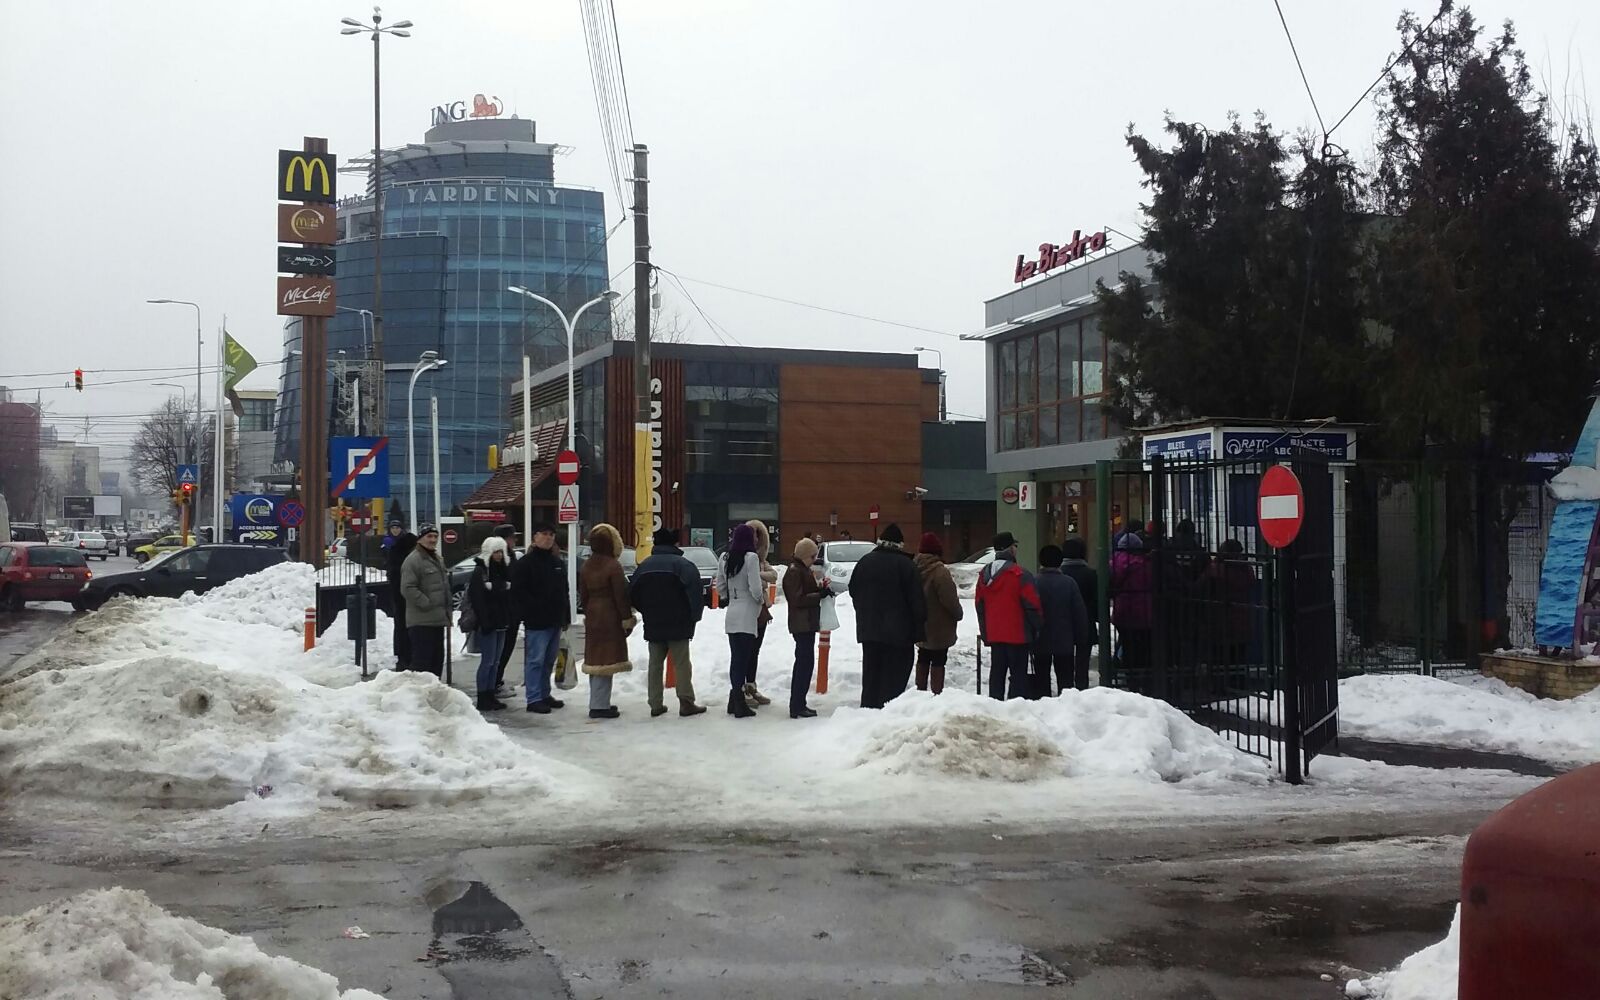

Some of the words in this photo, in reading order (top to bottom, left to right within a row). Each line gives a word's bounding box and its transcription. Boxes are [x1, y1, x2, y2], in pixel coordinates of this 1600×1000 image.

[431, 101, 466, 126] ING
[407, 186, 560, 204] YARDENNY
[1039, 230, 1106, 272] Bistro
